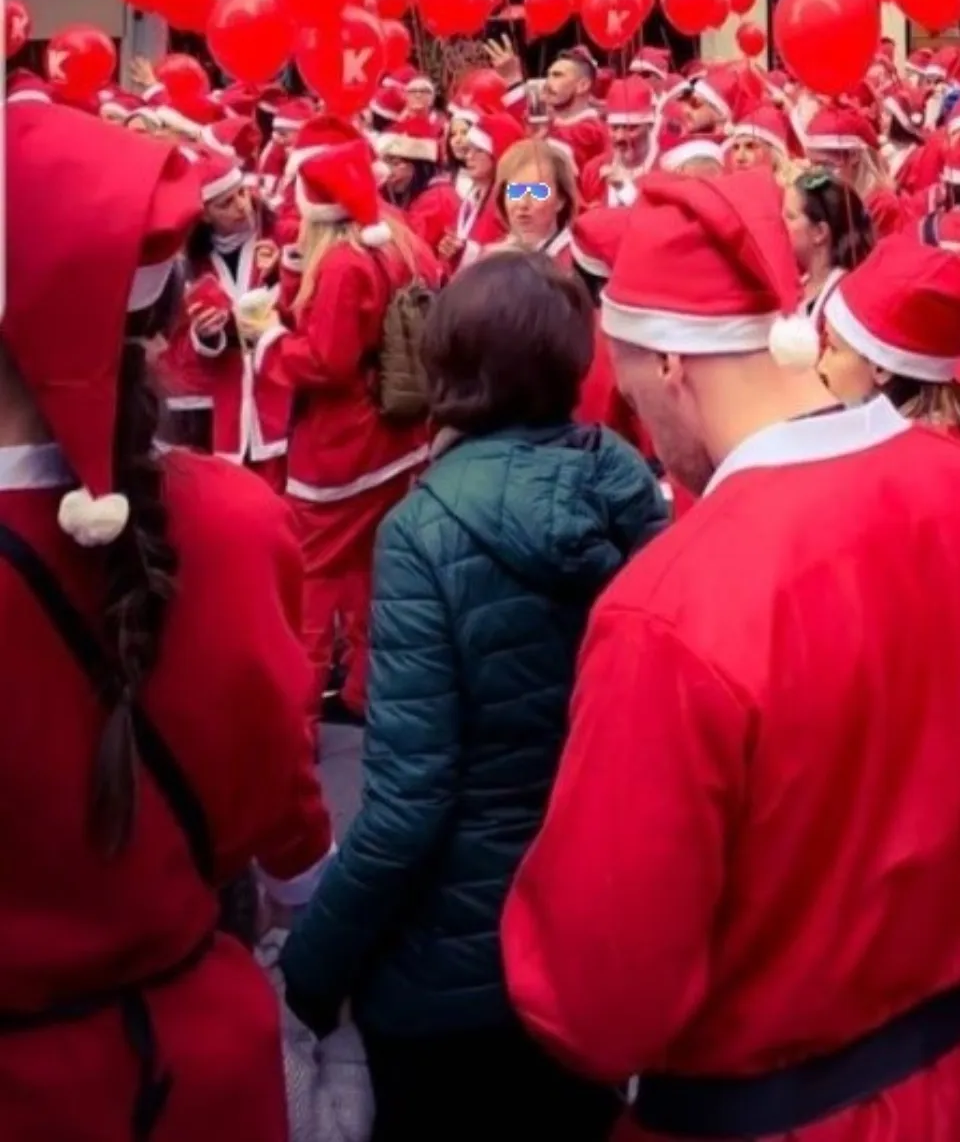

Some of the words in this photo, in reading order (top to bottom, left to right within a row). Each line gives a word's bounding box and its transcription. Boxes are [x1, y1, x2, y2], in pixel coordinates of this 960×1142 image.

[606, 10, 631, 36] K
[47, 49, 70, 79] K
[343, 46, 374, 85] K
